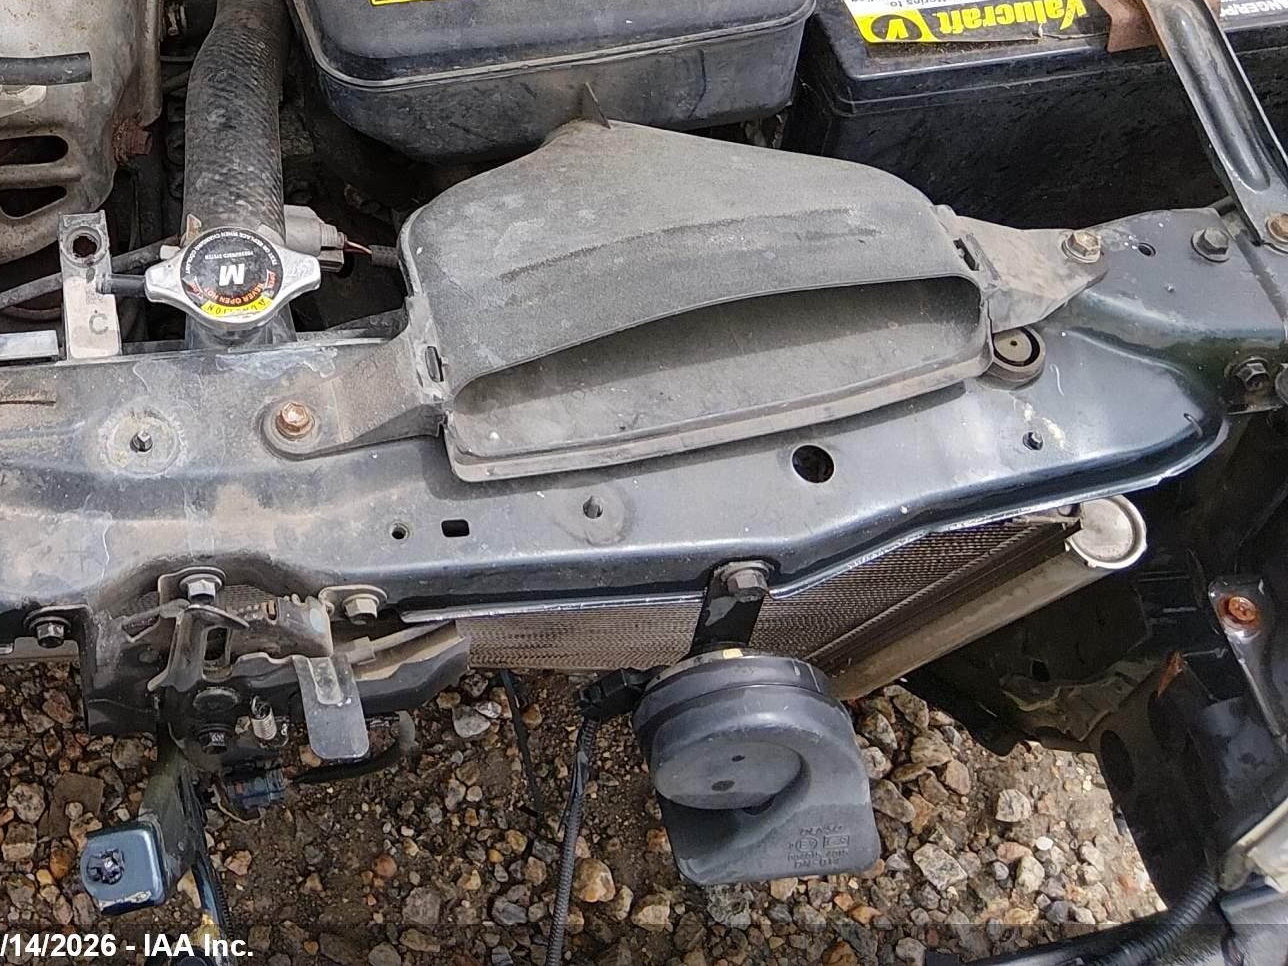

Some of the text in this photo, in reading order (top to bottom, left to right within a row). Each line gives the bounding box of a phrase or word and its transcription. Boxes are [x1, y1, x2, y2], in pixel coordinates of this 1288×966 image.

[890, 0, 903, 8] to
[203, 287, 219, 302] HOT
[219, 296, 242, 304] OPEN
